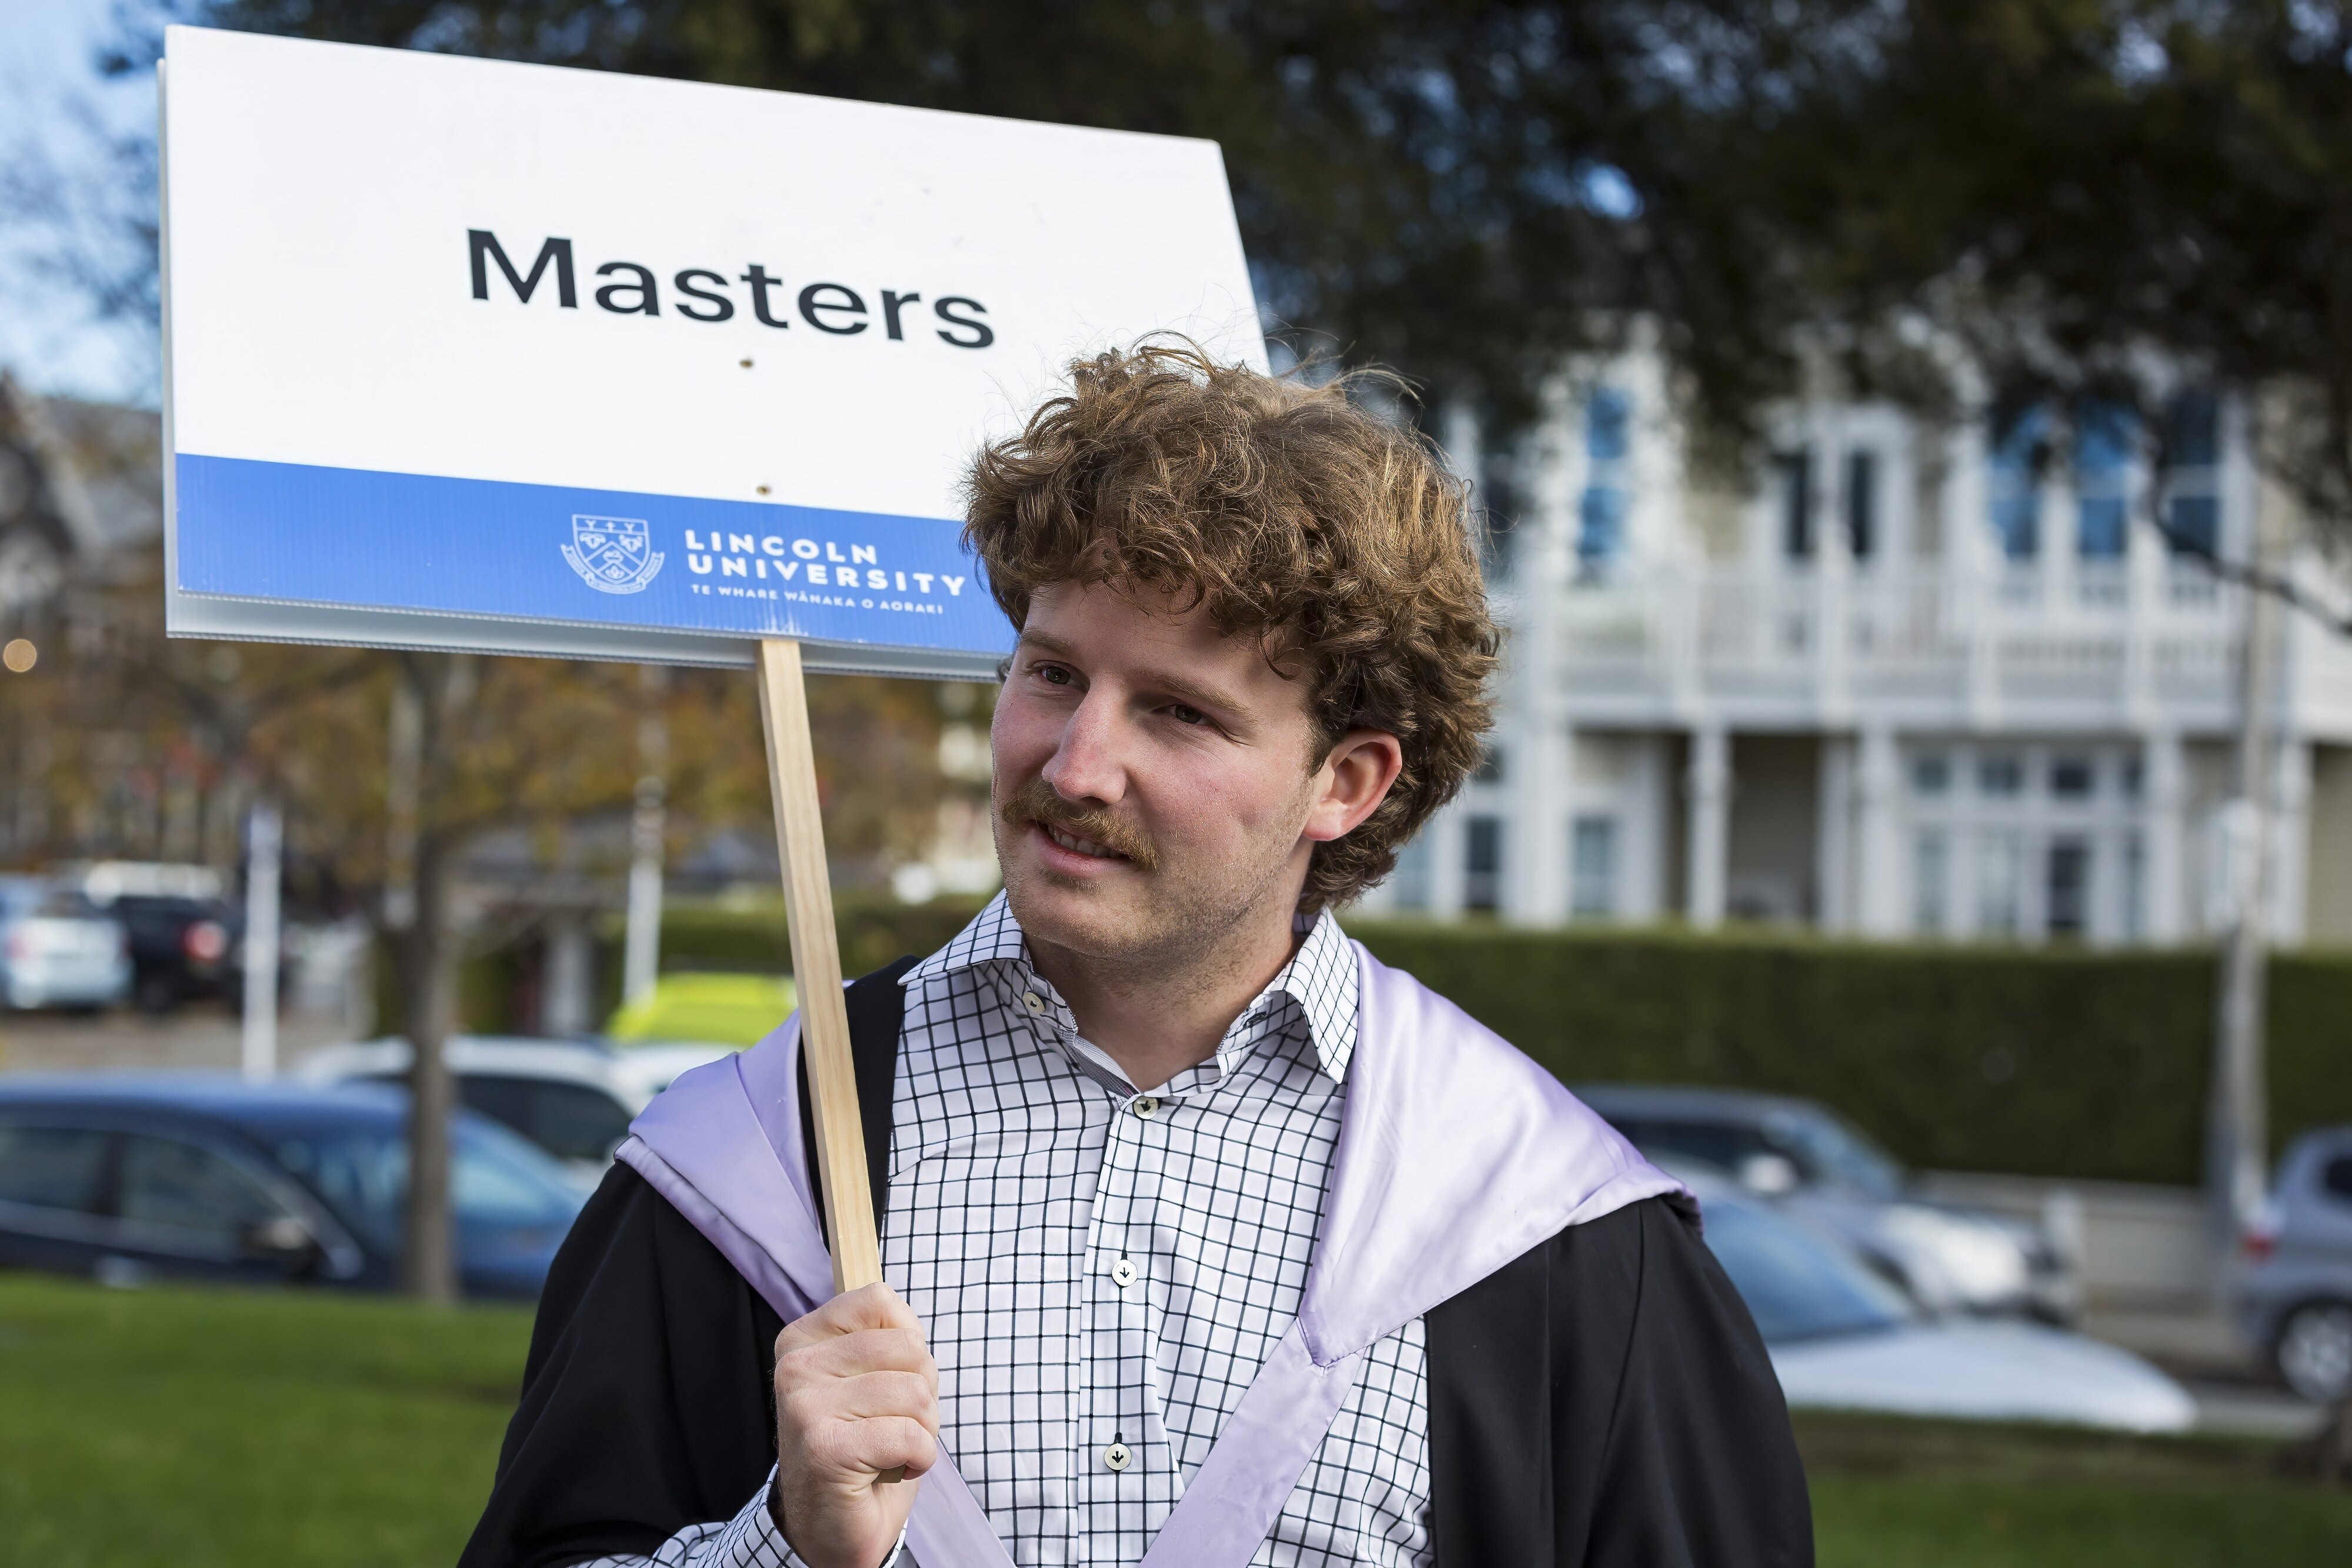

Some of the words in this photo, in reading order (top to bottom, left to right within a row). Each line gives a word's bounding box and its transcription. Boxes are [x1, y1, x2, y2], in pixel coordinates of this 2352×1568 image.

[467, 229, 996, 349] Masters
[685, 529, 878, 565] LINCOLN
[688, 554, 966, 596] UNIVERSITY
[691, 584, 710, 595] TE
[718, 586, 778, 600] WHARE
[783, 590, 856, 608] WĀNAKA
[862, 599, 875, 609] O
[879, 600, 943, 615] AORAKI
